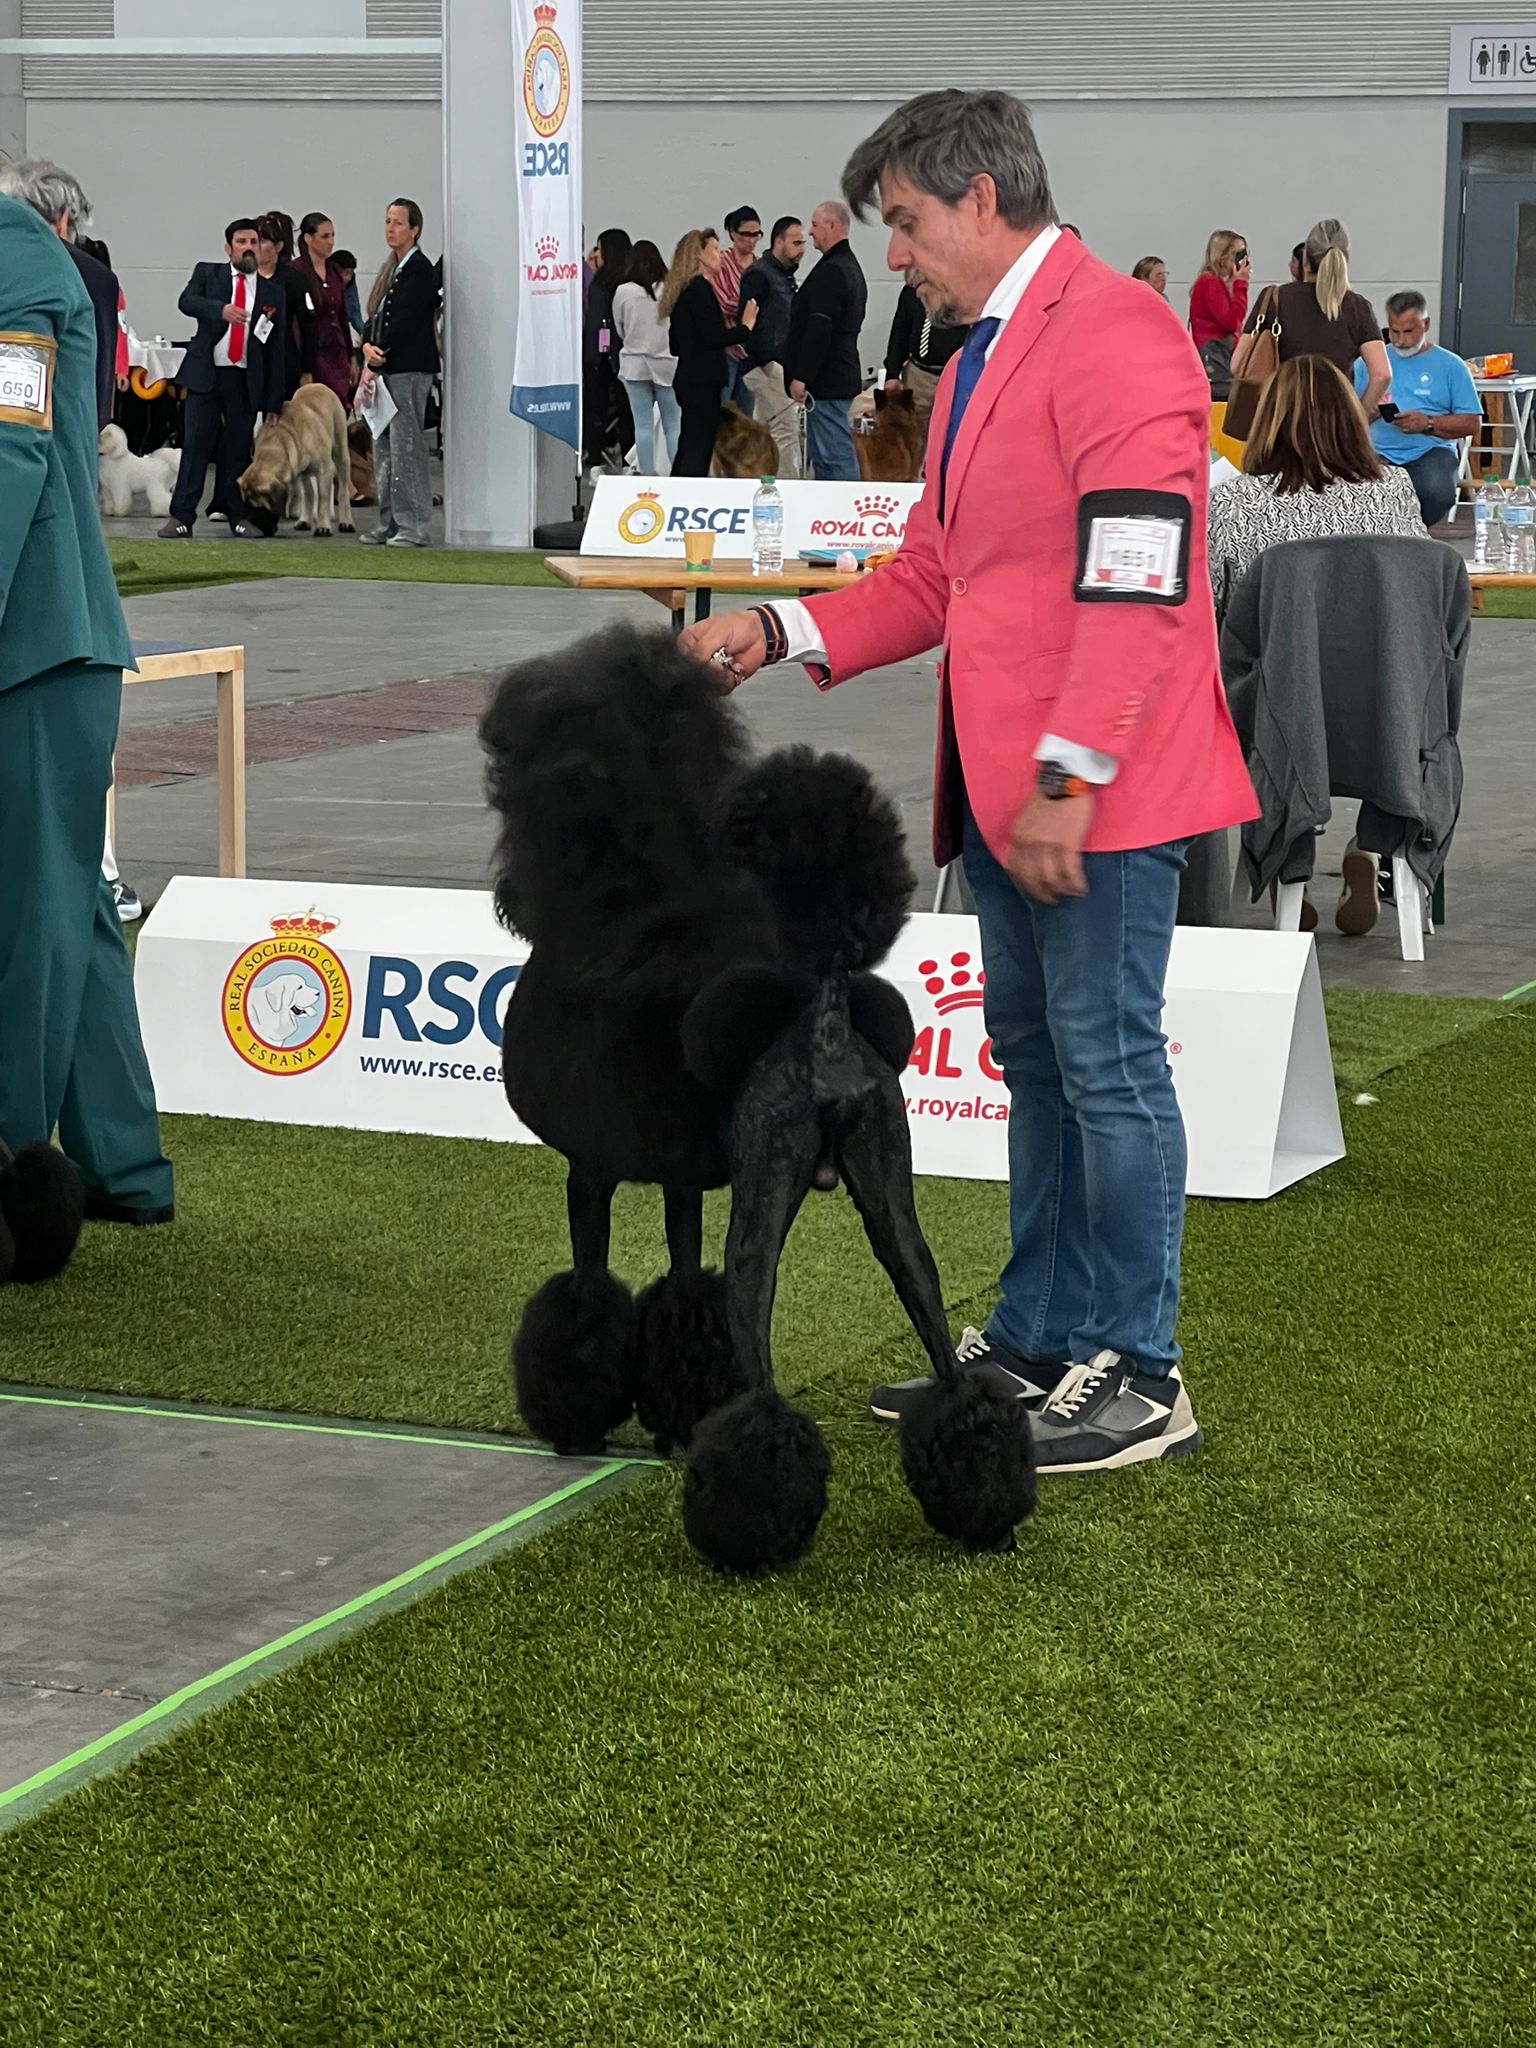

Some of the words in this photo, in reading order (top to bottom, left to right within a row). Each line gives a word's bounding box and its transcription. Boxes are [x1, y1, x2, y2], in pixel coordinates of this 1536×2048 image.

[2, 380, 33, 398] 650
[667, 506, 750, 534] RSCE
[810, 520, 866, 536] ROYAL
[229, 973, 247, 1011] REAL
[244, 942, 319, 971] SOCIEDAD
[320, 958, 344, 1019] CANINA
[247, 1042, 317, 1067] ESPAÑA
